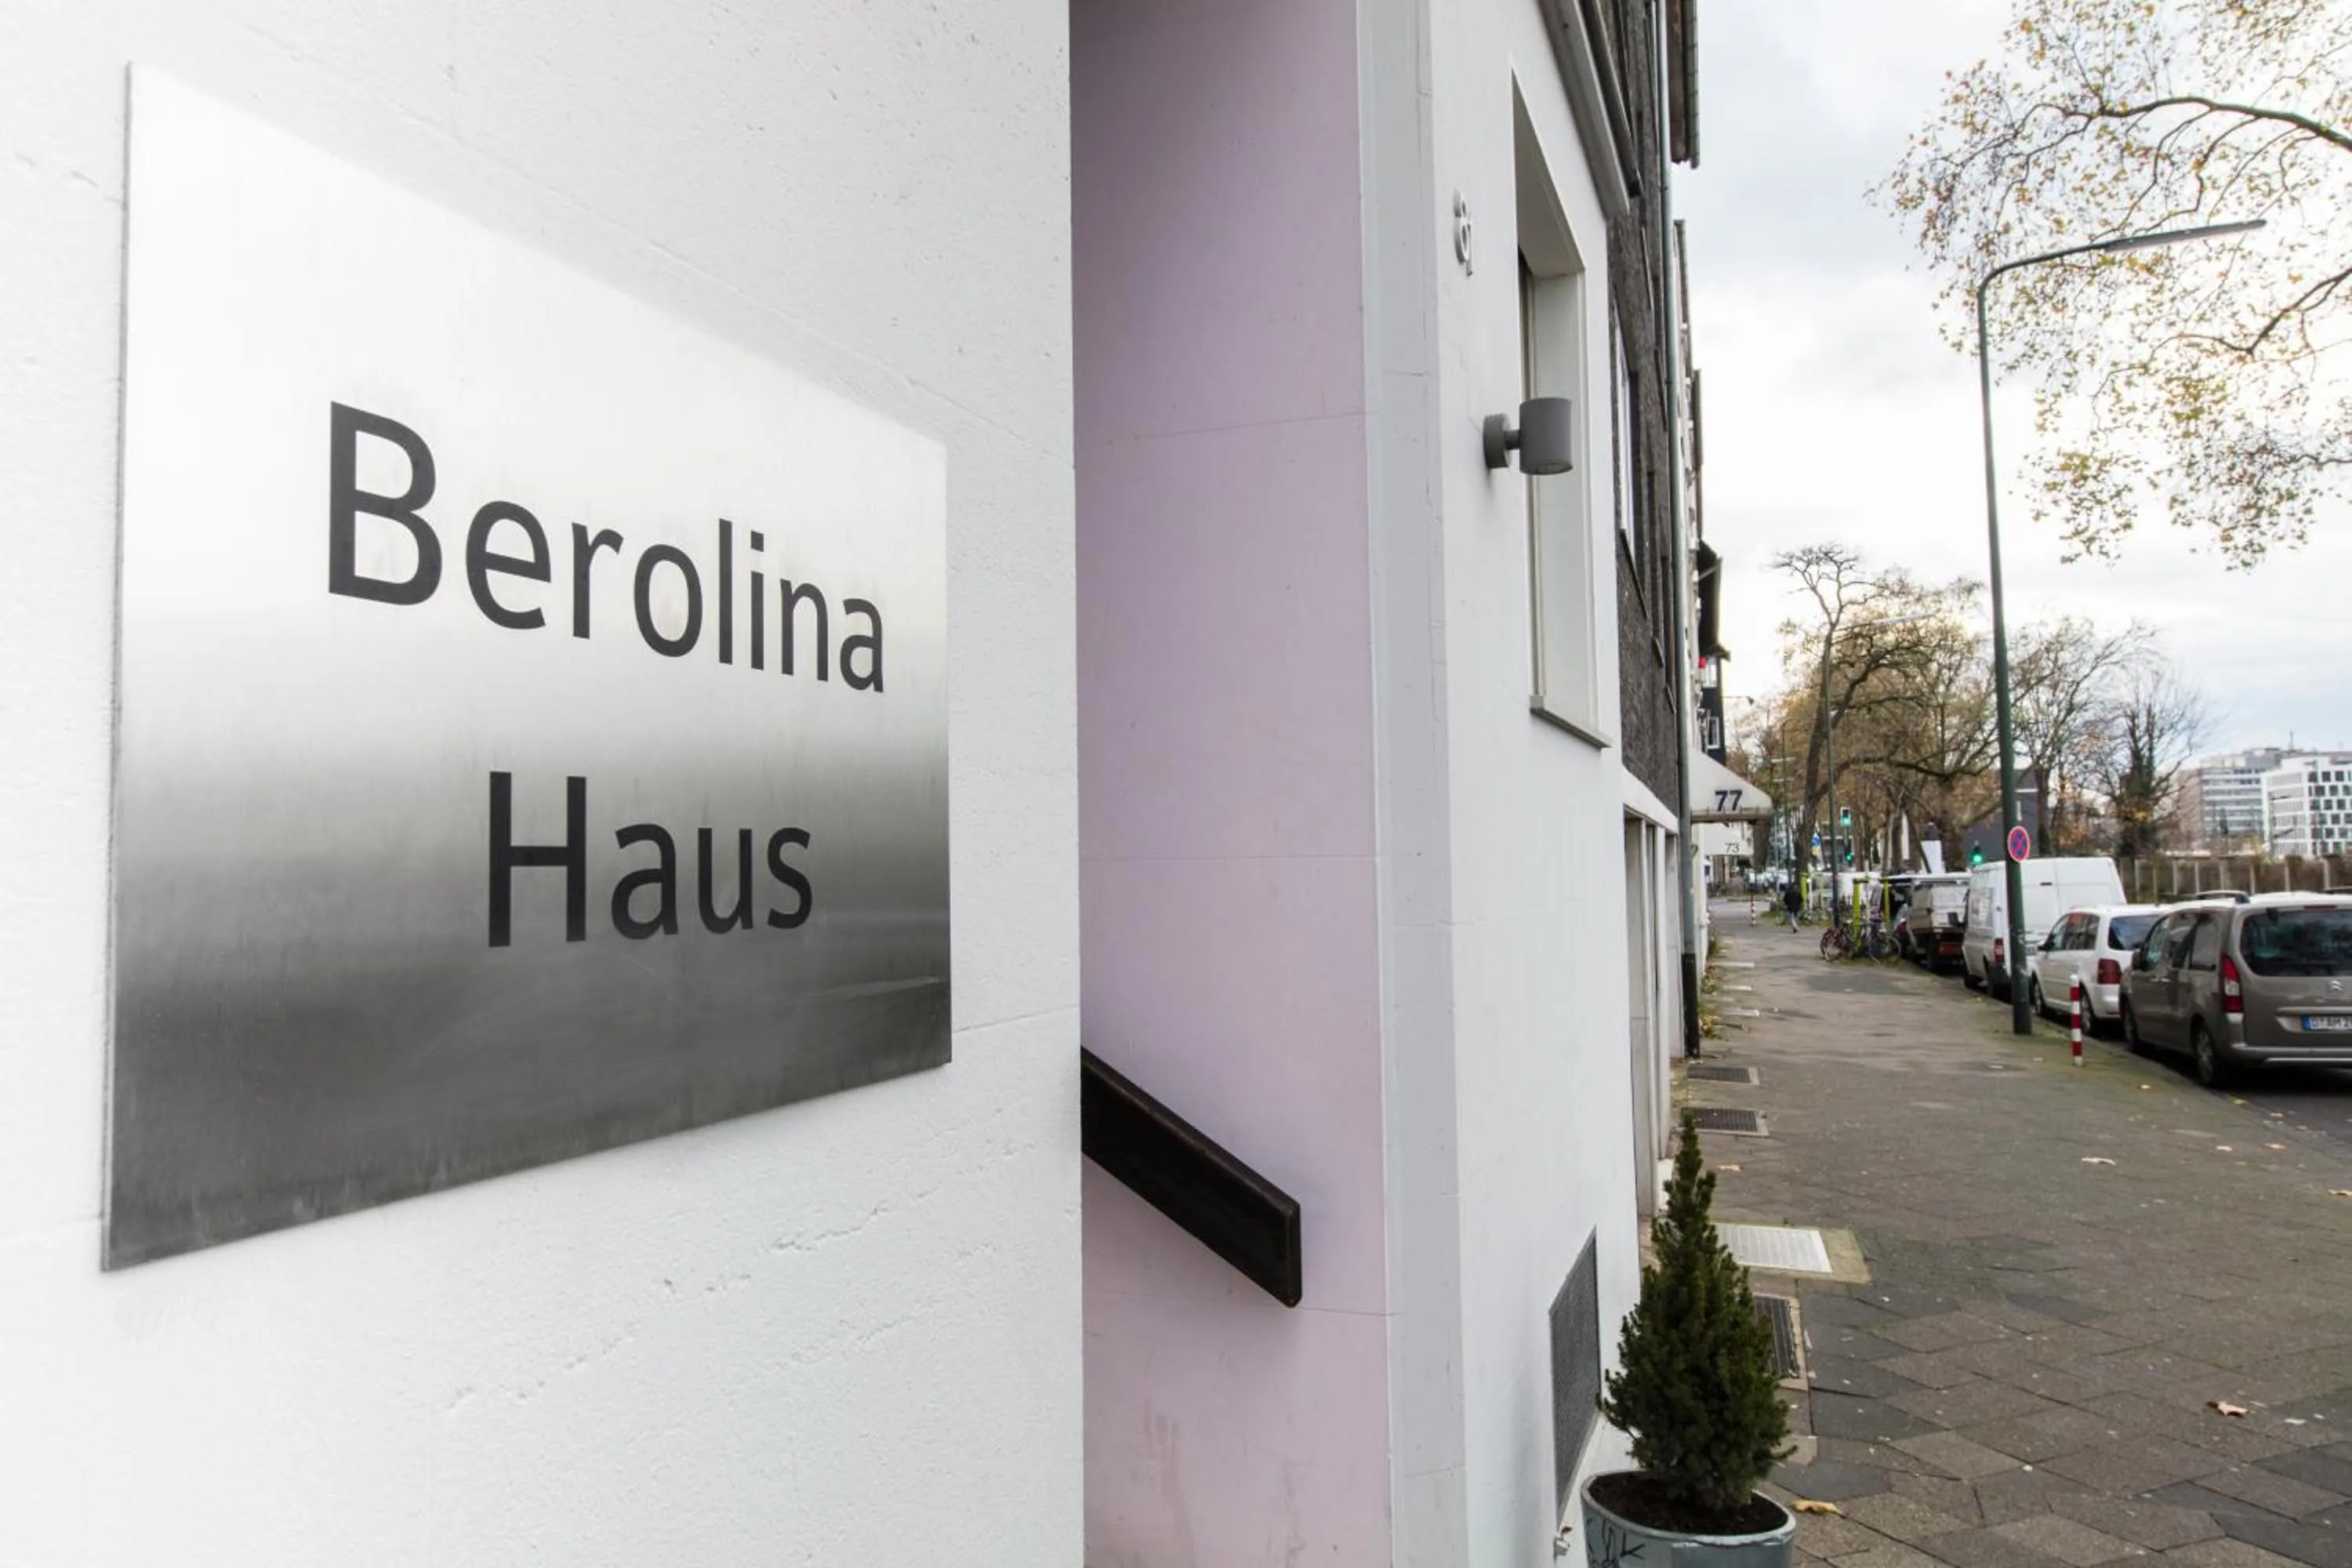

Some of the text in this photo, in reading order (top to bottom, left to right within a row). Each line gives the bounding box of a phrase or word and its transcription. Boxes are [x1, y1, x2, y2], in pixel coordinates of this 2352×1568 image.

[328, 400, 884, 694] Berolina
[1715, 789, 1743, 812] 77
[1724, 841, 1740, 854] 73
[488, 770, 813, 948] Haus
